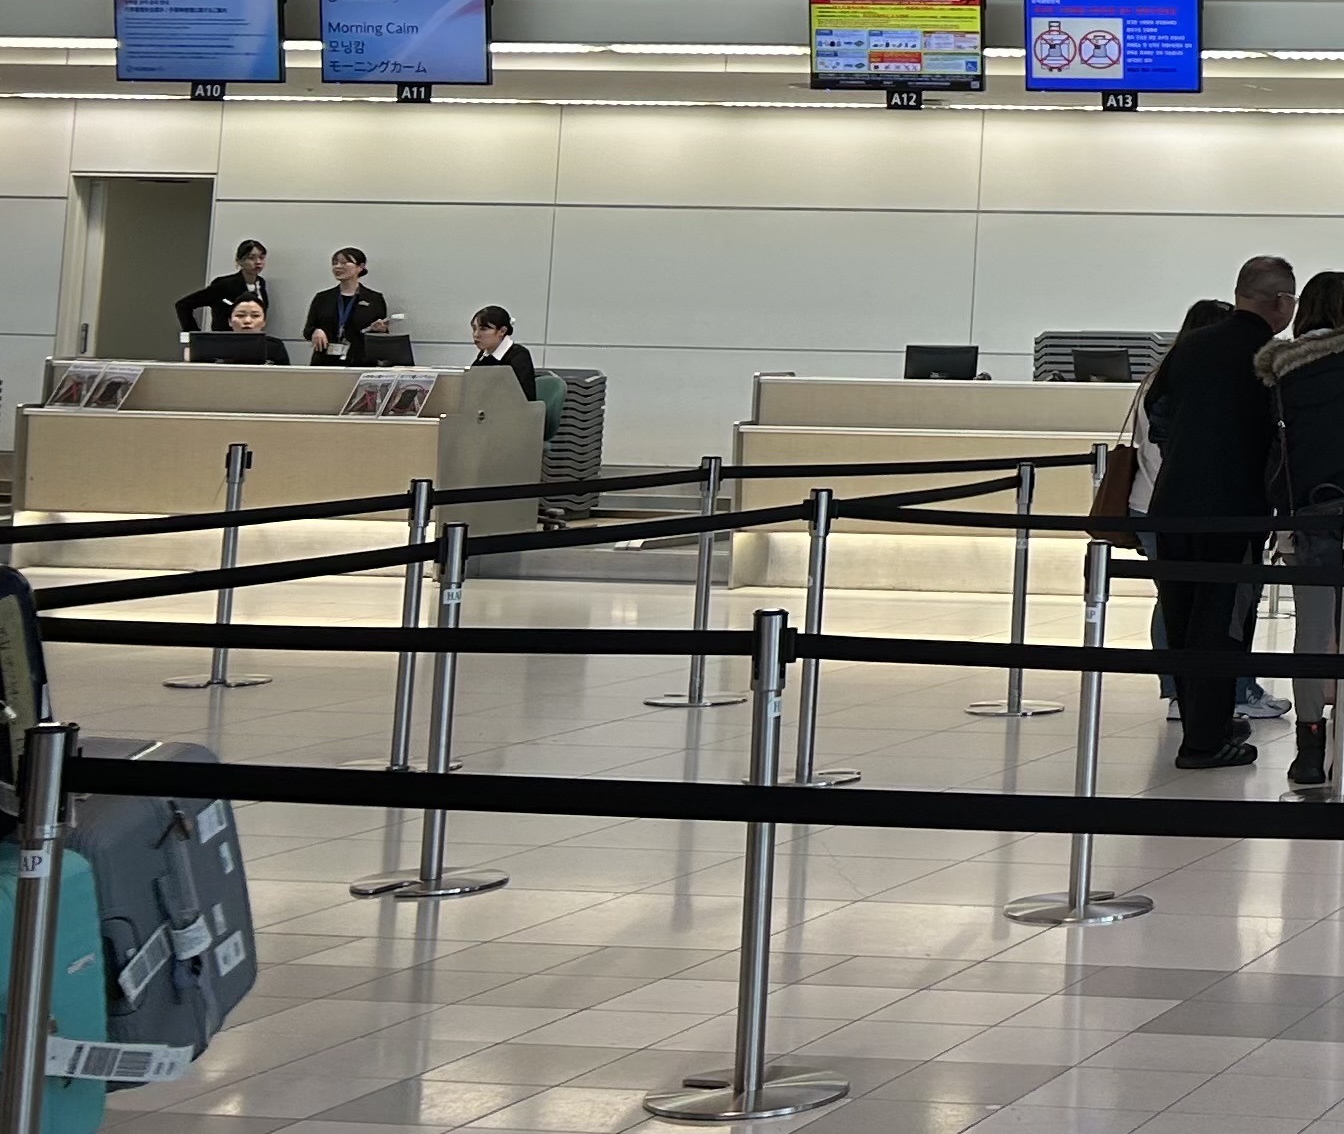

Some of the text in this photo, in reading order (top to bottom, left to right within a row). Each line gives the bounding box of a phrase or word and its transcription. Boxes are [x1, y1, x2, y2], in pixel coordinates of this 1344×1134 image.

[327, 22, 419, 37] Morning Calm
[329, 40, 366, 55] 모닝캄
[329, 60, 428, 74] モーニングカーム
[195, 84, 221, 98] A10
[401, 86, 426, 100] A11
[890, 92, 917, 107] A12
[1106, 93, 1133, 108] A13
